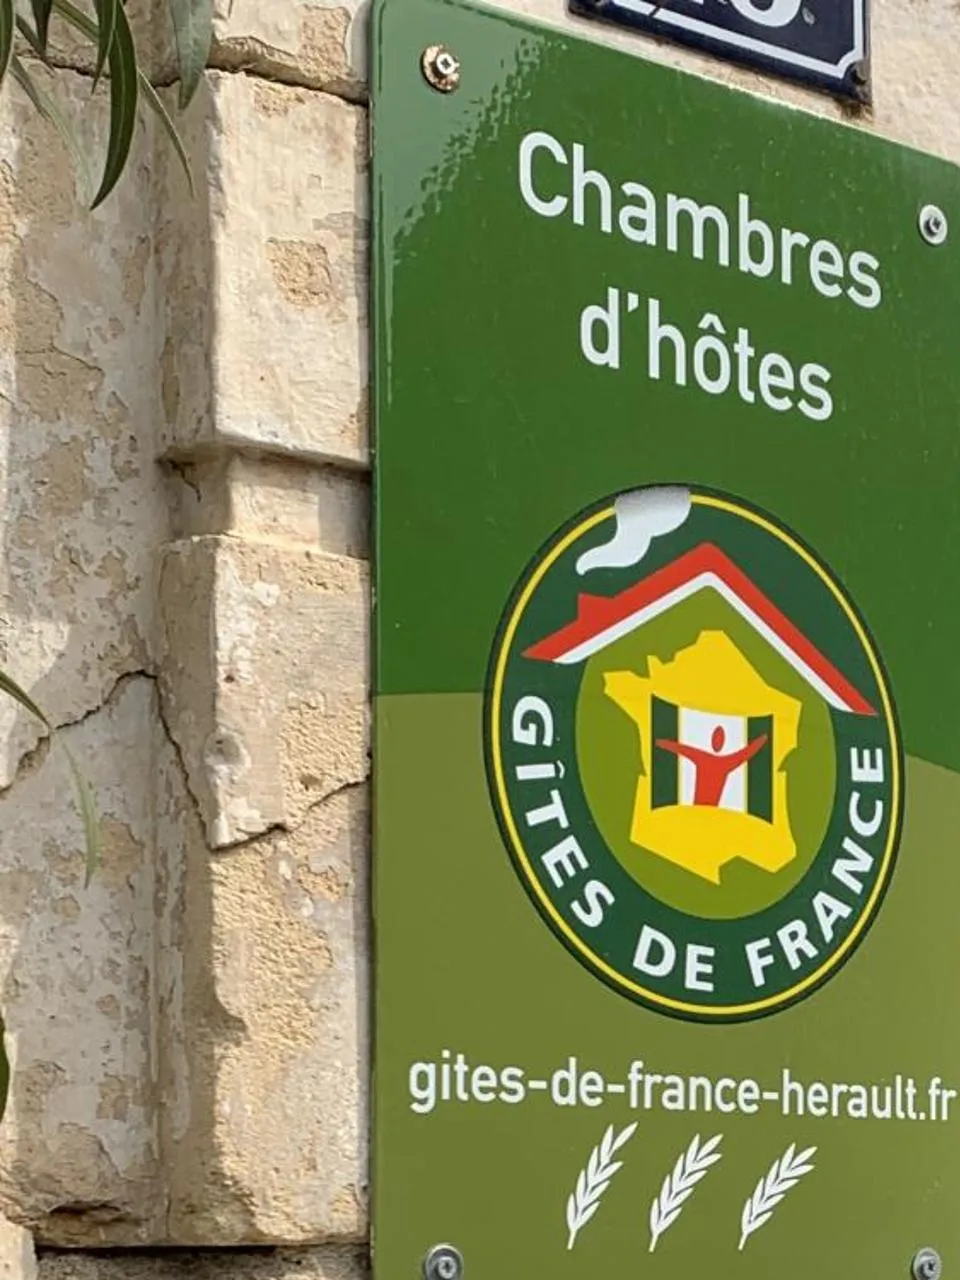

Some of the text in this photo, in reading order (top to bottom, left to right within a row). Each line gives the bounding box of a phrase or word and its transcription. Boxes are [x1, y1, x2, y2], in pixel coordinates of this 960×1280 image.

[518, 131, 882, 309] Chambres
[580, 286, 833, 421] d'hôtes
[512, 696, 884, 992] GÎTES DE FRANCE
[408, 1049, 957, 1121] gites-de-france-herault.fr
